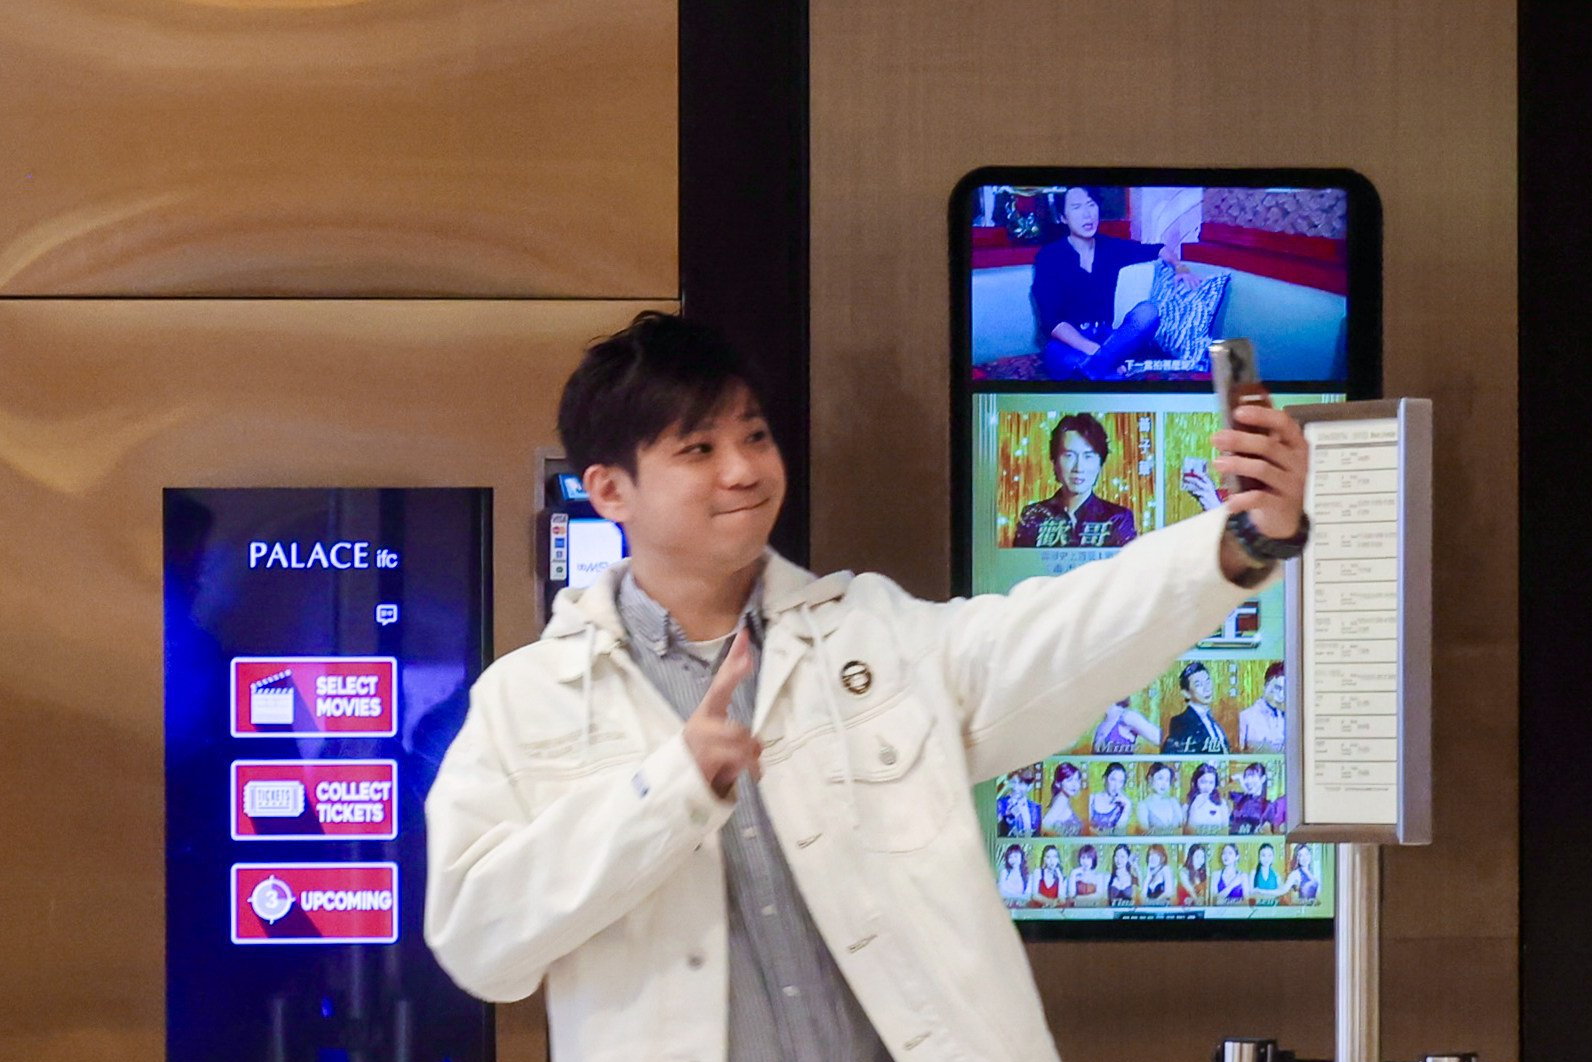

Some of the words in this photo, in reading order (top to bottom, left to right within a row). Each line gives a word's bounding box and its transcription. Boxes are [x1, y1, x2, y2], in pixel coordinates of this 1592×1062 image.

[250, 542, 369, 569] PALACE
[376, 549, 398, 569] ifc
[316, 675, 379, 696] SELECT
[316, 697, 382, 717] MOVIES
[316, 781, 392, 802] COLLECT
[316, 803, 384, 823] TICKETS
[265, 891, 278, 909] 3
[301, 890, 393, 911] UPCOMING
